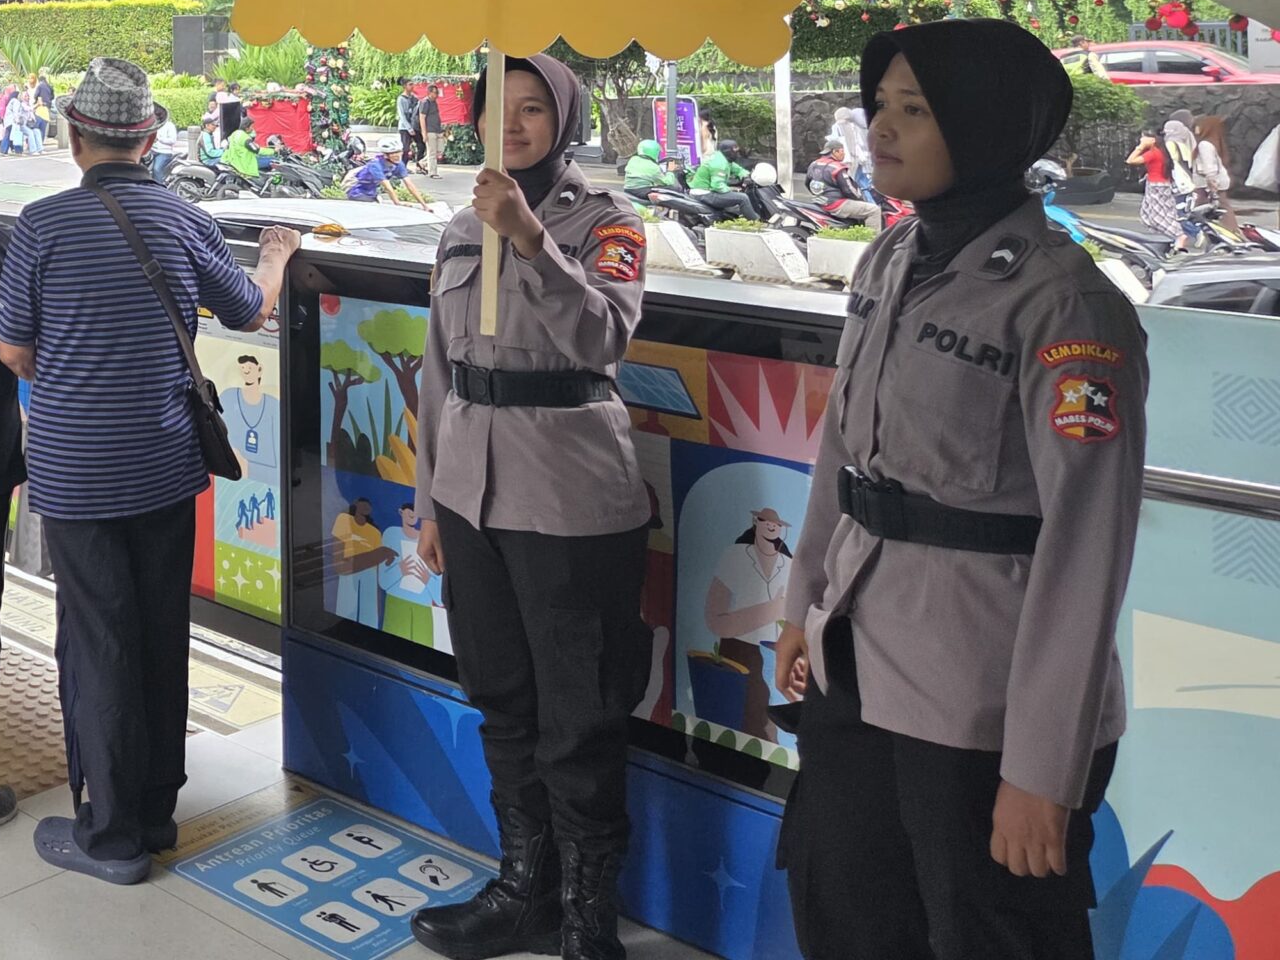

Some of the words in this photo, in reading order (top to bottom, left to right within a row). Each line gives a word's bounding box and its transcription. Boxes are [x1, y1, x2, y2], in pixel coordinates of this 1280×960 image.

[916, 322, 1015, 376] POLRI
[1043, 343, 1119, 362] LEMDIKLAT
[1054, 414, 1086, 426] MABES
[194, 838, 263, 872] Antrean
[261, 806, 334, 841] Prioritas
[235, 841, 283, 868] Priority
[283, 825, 321, 847] Queue
